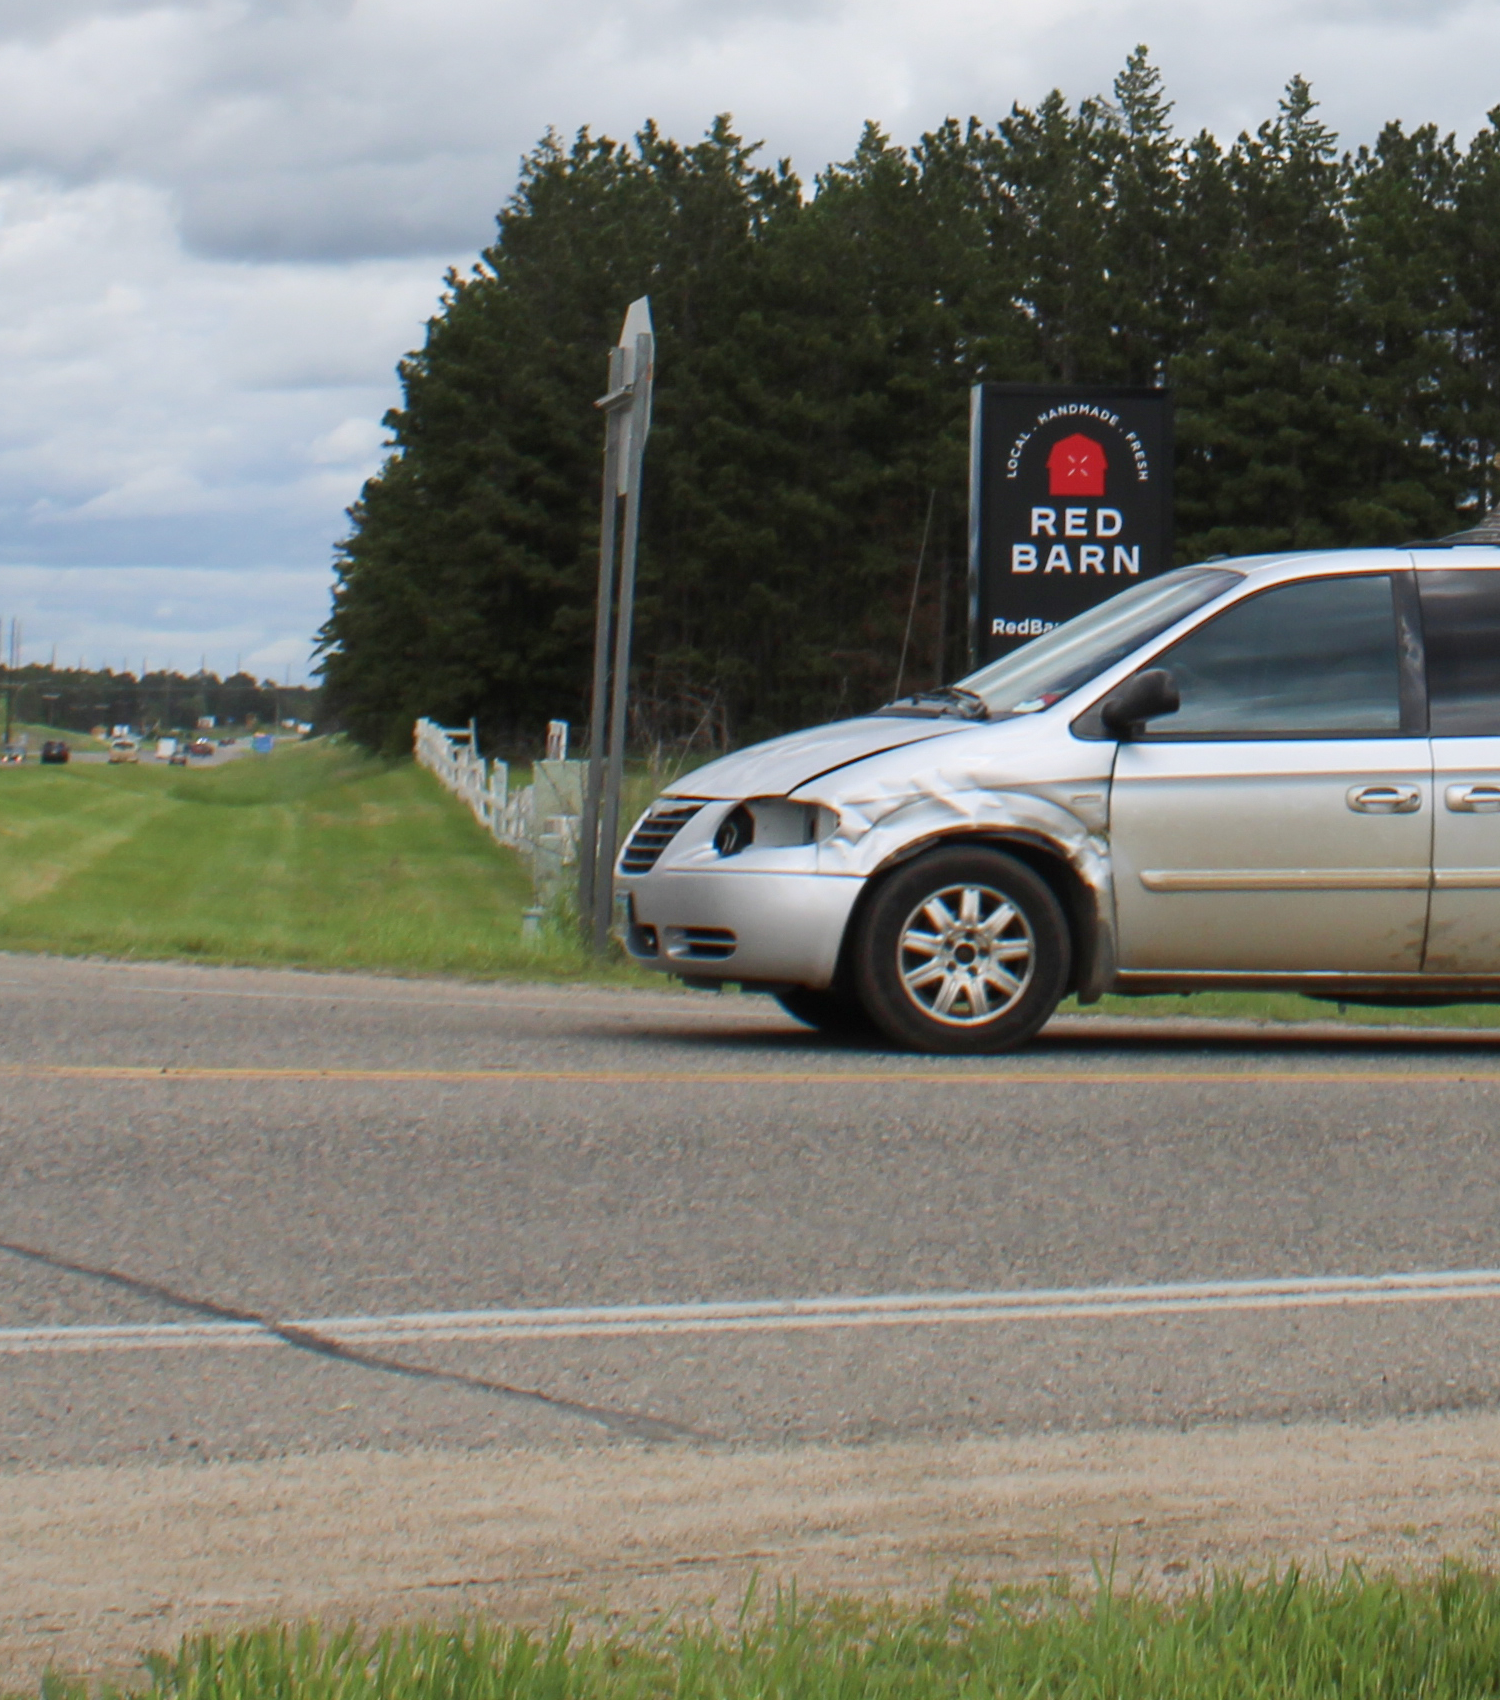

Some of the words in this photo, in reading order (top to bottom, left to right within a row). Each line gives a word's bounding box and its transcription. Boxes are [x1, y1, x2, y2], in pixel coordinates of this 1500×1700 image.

[1007, 432, 1031, 478] LOCAL
[1037, 404, 1119, 426] HANDMADE
[1125, 431, 1149, 480] FRESH
[1031, 507, 1123, 537] RED
[1011, 543, 1140, 574] BARN
[992, 618, 1060, 636] RedBa
